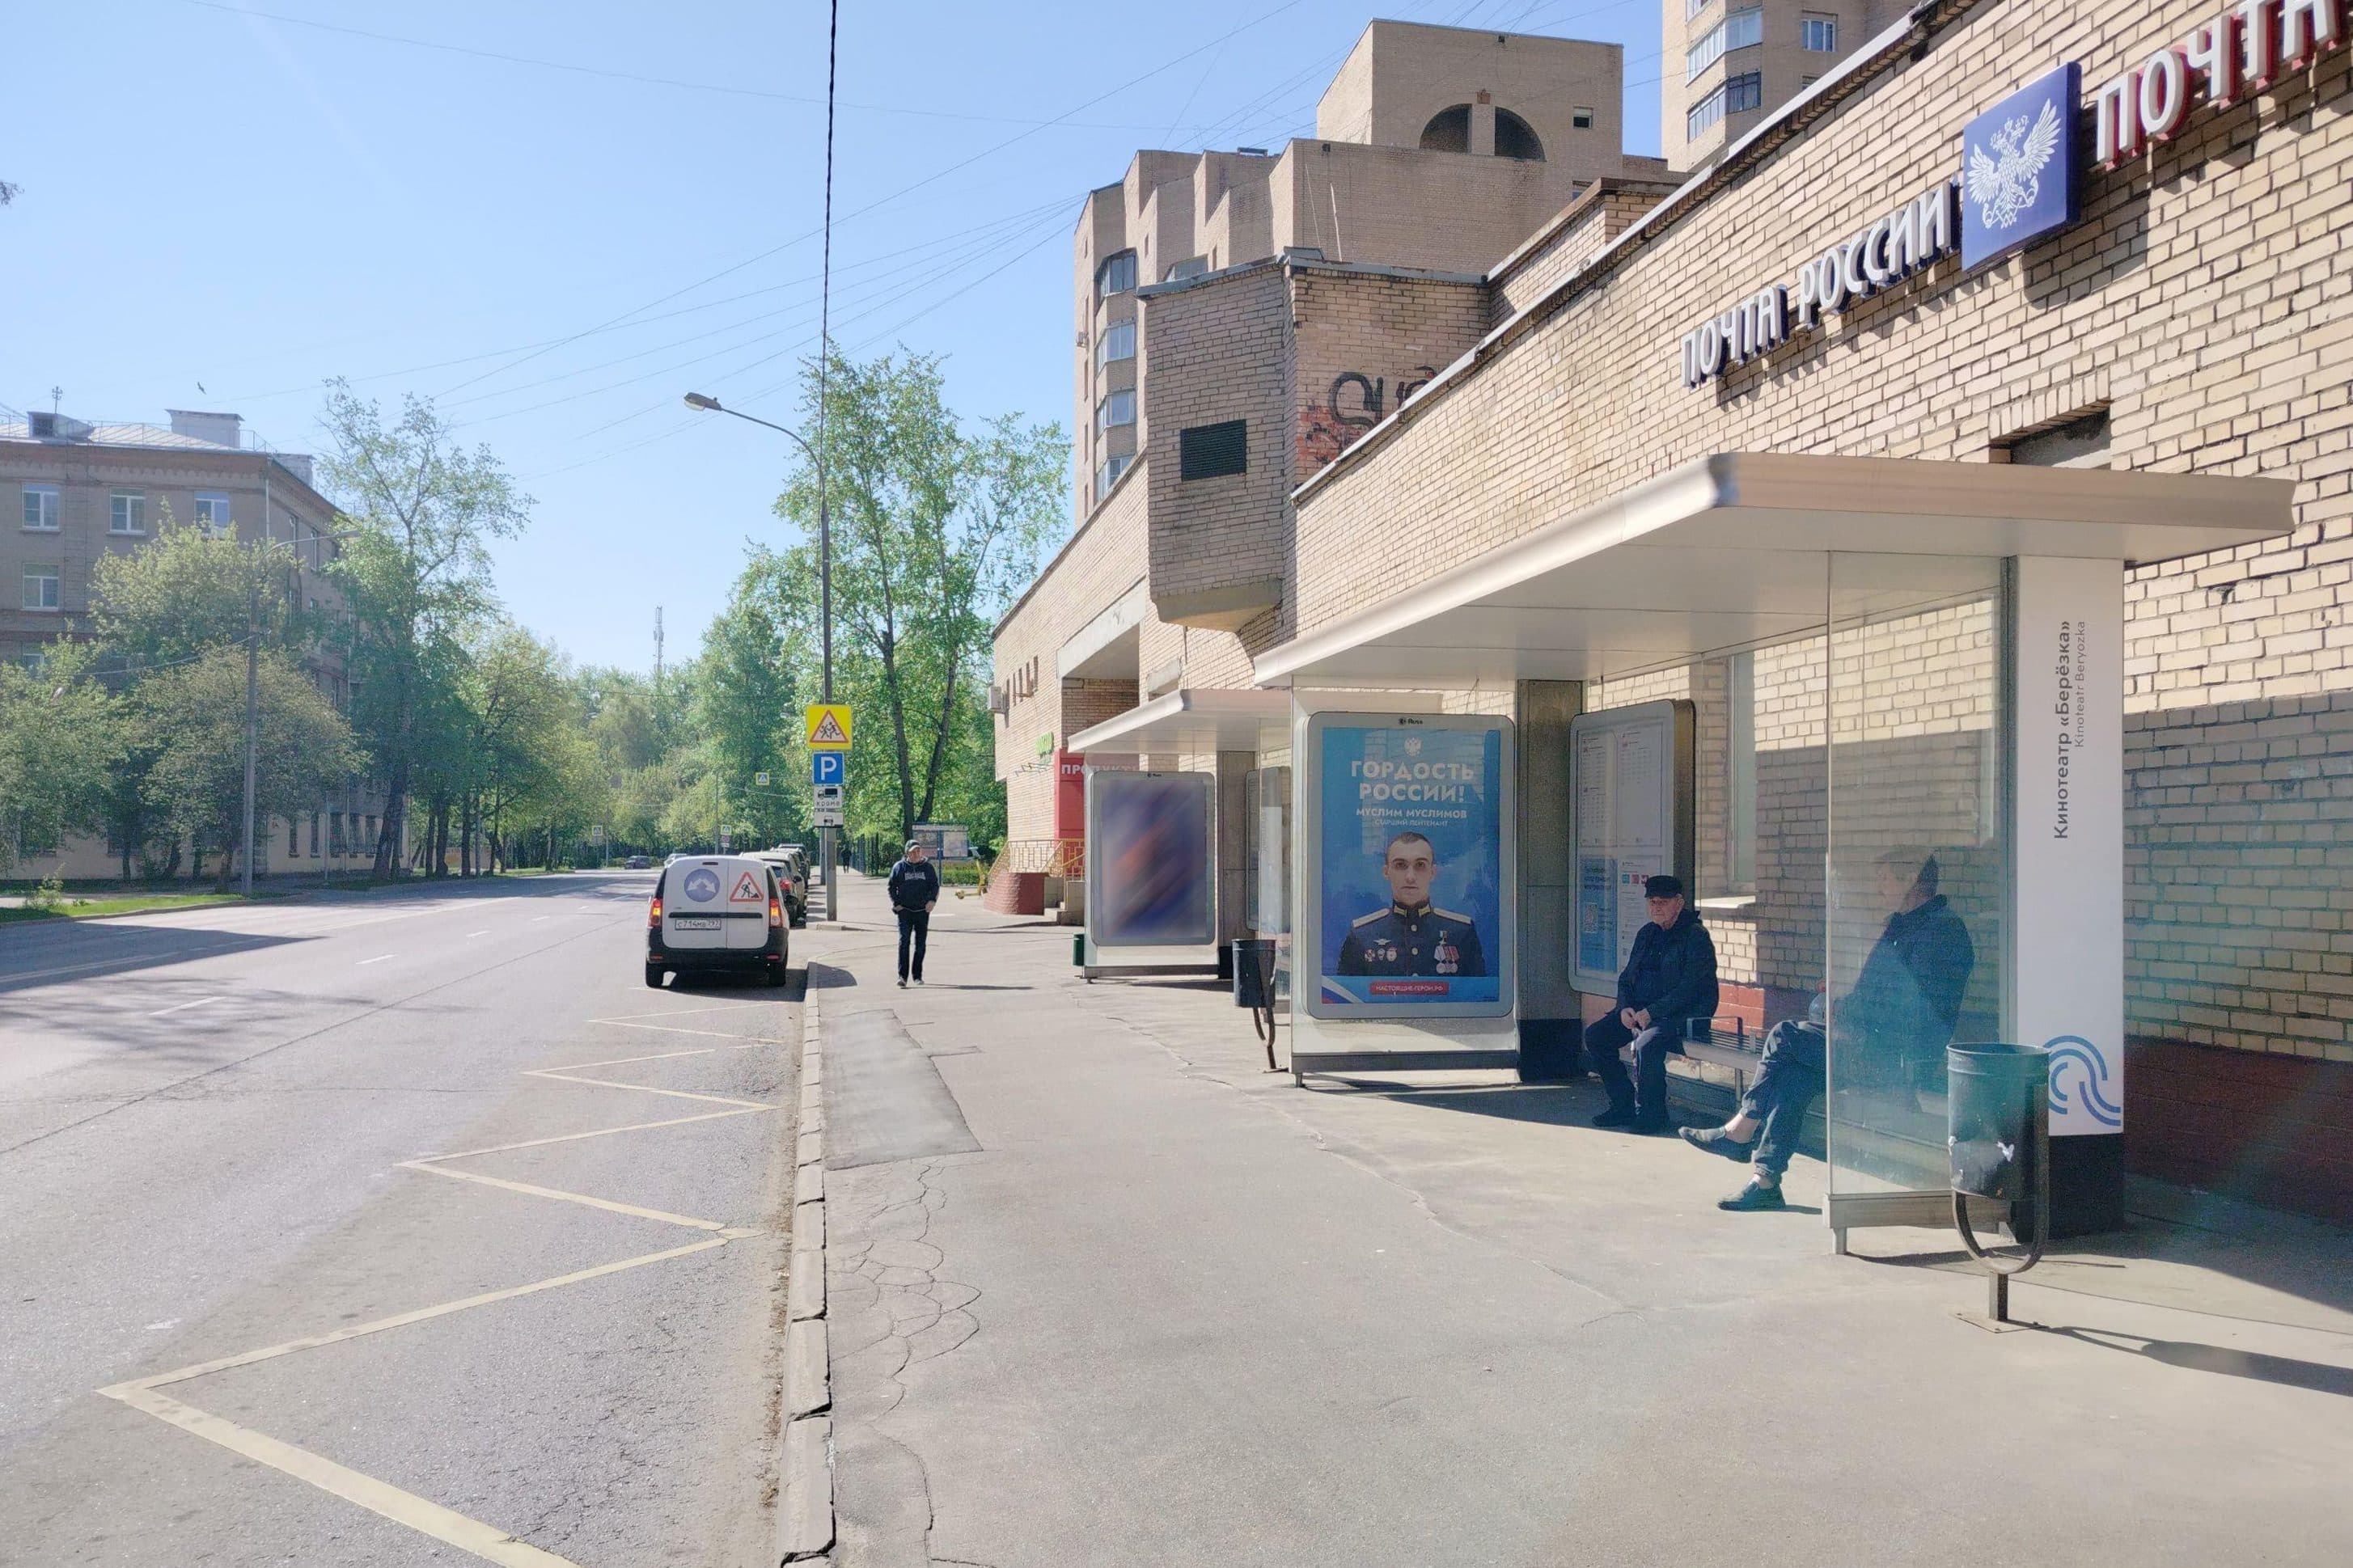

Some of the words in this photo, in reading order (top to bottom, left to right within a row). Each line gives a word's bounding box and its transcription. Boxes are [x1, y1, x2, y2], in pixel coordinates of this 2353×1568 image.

[2097, 0, 2334, 166] ПОЧТА
[1682, 285, 1787, 389] ПОЧТА
[1798, 181, 1957, 326] РОССИИ
[2055, 621, 2073, 726] «Берёзка»
[2075, 621, 2085, 682] Beryozka
[2075, 686, 2084, 747] Kinoteatr
[820, 756, 837, 780] P
[1351, 760, 1474, 781] ГОРДОСТЬ
[1359, 783, 1465, 803] РОССИИ!
[2054, 733, 2072, 839] Кинотеатр
[1356, 808, 1403, 818] МУСЛИМ
[1406, 809, 1467, 819] МУСЛИМОВ
